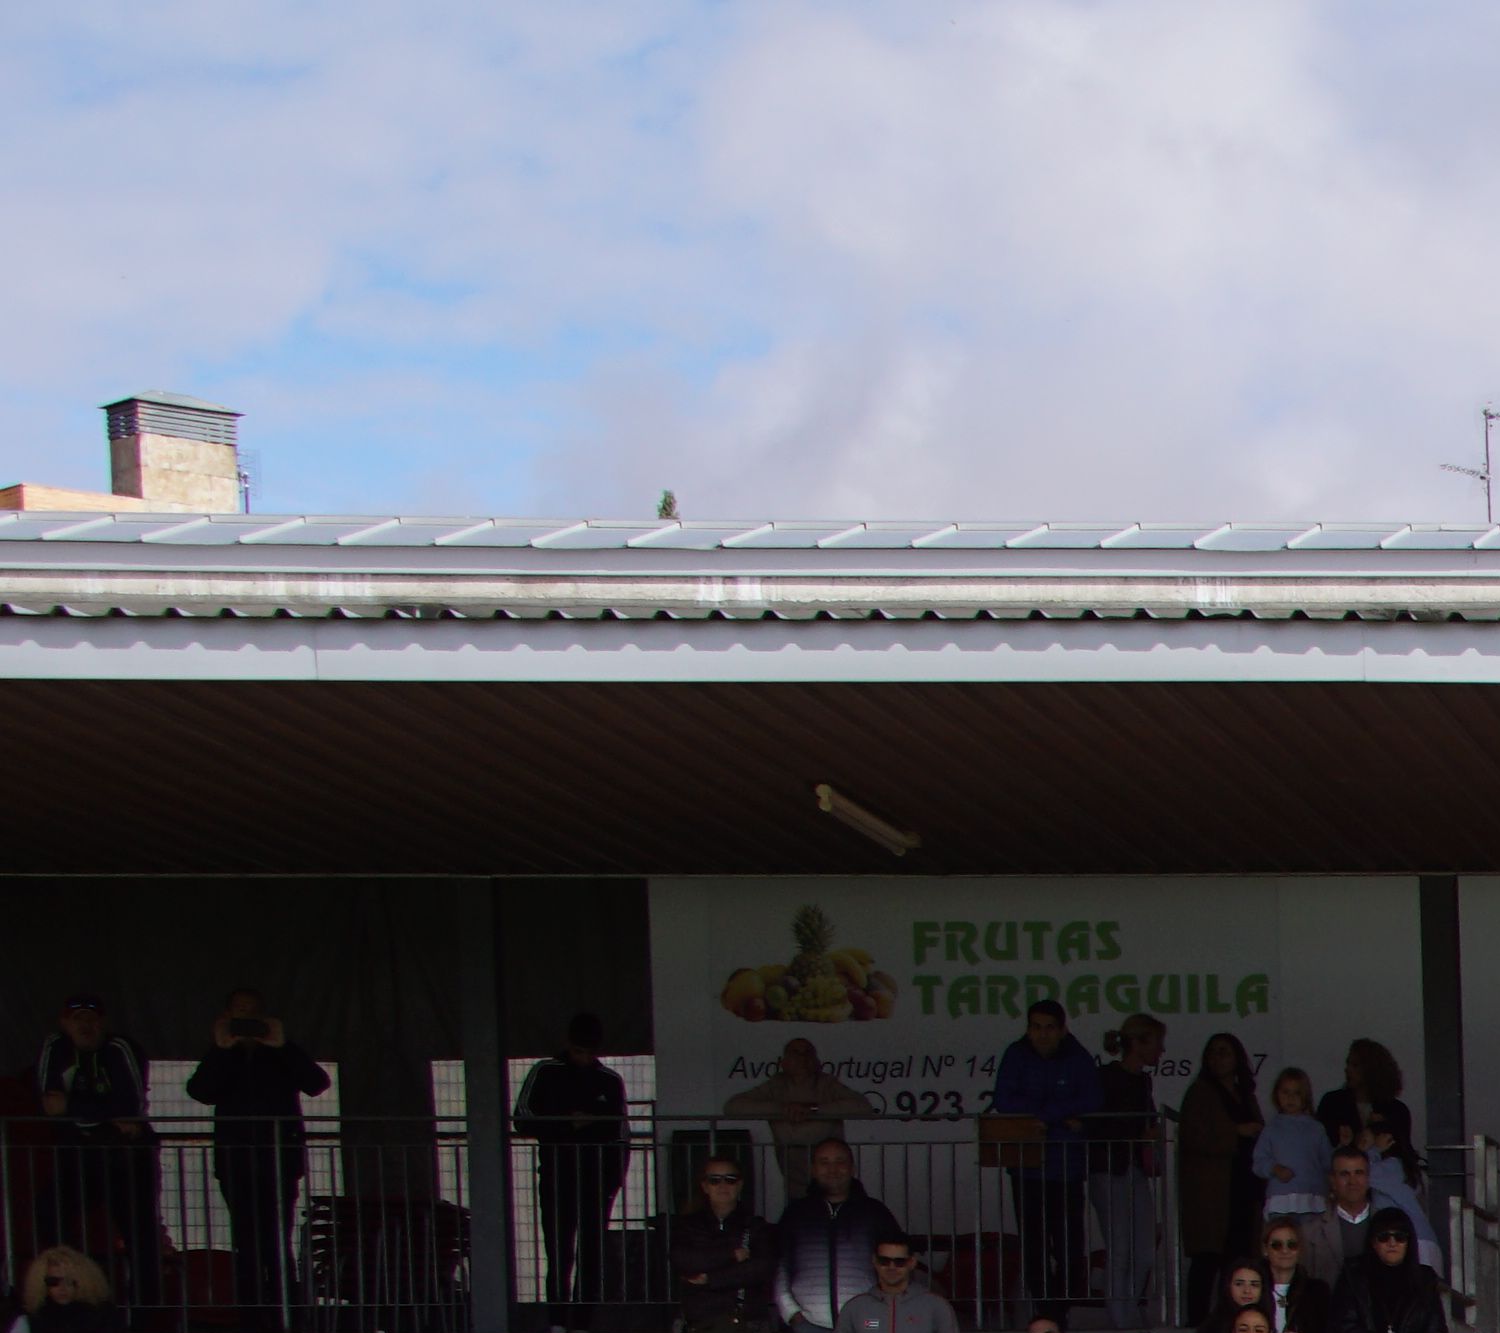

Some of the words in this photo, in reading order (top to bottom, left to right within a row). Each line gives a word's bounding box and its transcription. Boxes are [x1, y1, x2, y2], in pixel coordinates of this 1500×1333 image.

[912, 920, 1123, 965] FRUTAS
[912, 973, 1270, 1019] TARDAGUILA
[821, 1055, 913, 1083] ortugal
